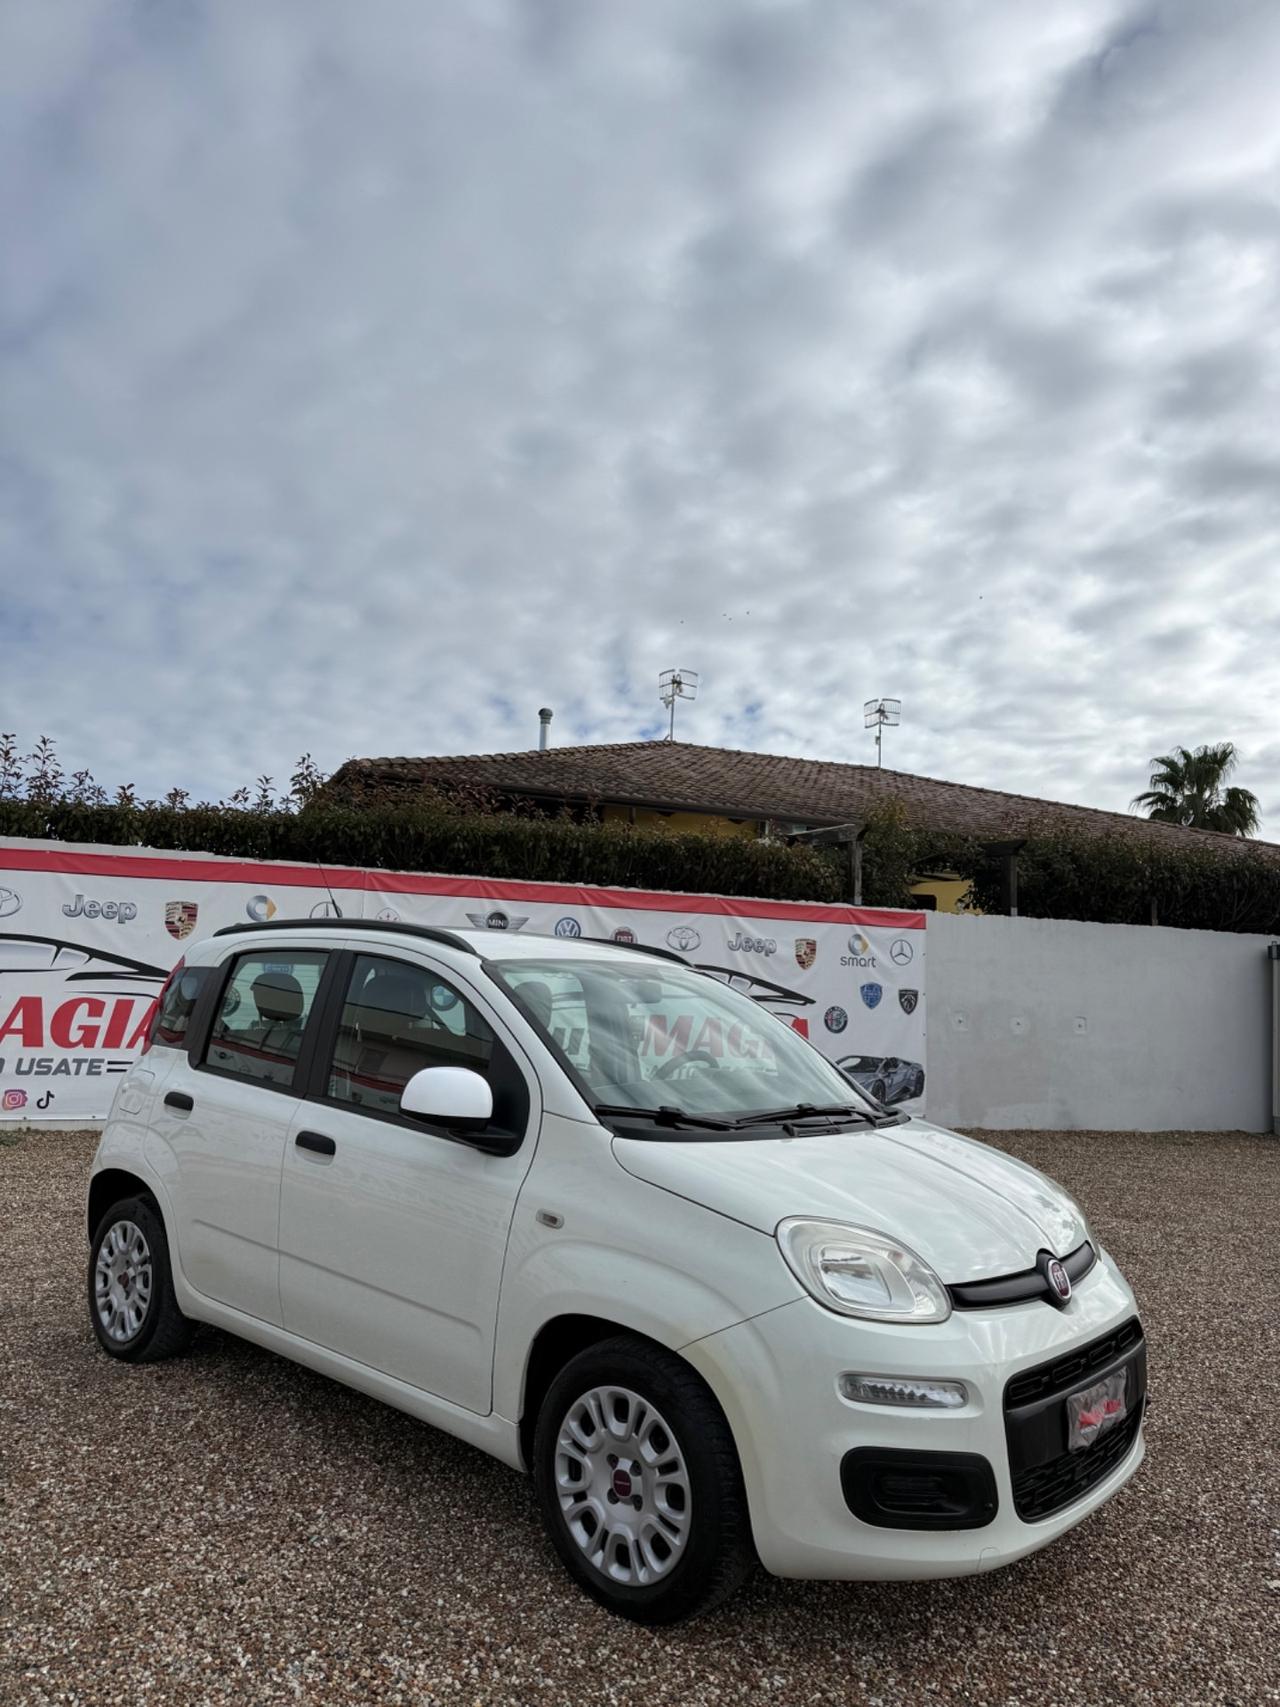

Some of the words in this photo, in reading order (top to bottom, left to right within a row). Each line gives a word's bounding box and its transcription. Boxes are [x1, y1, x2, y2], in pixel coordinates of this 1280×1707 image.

[62, 895, 138, 924] Jeep
[727, 932, 777, 957] Jeep
[840, 955, 877, 968] smart
[15, 1057, 105, 1076] USATE
